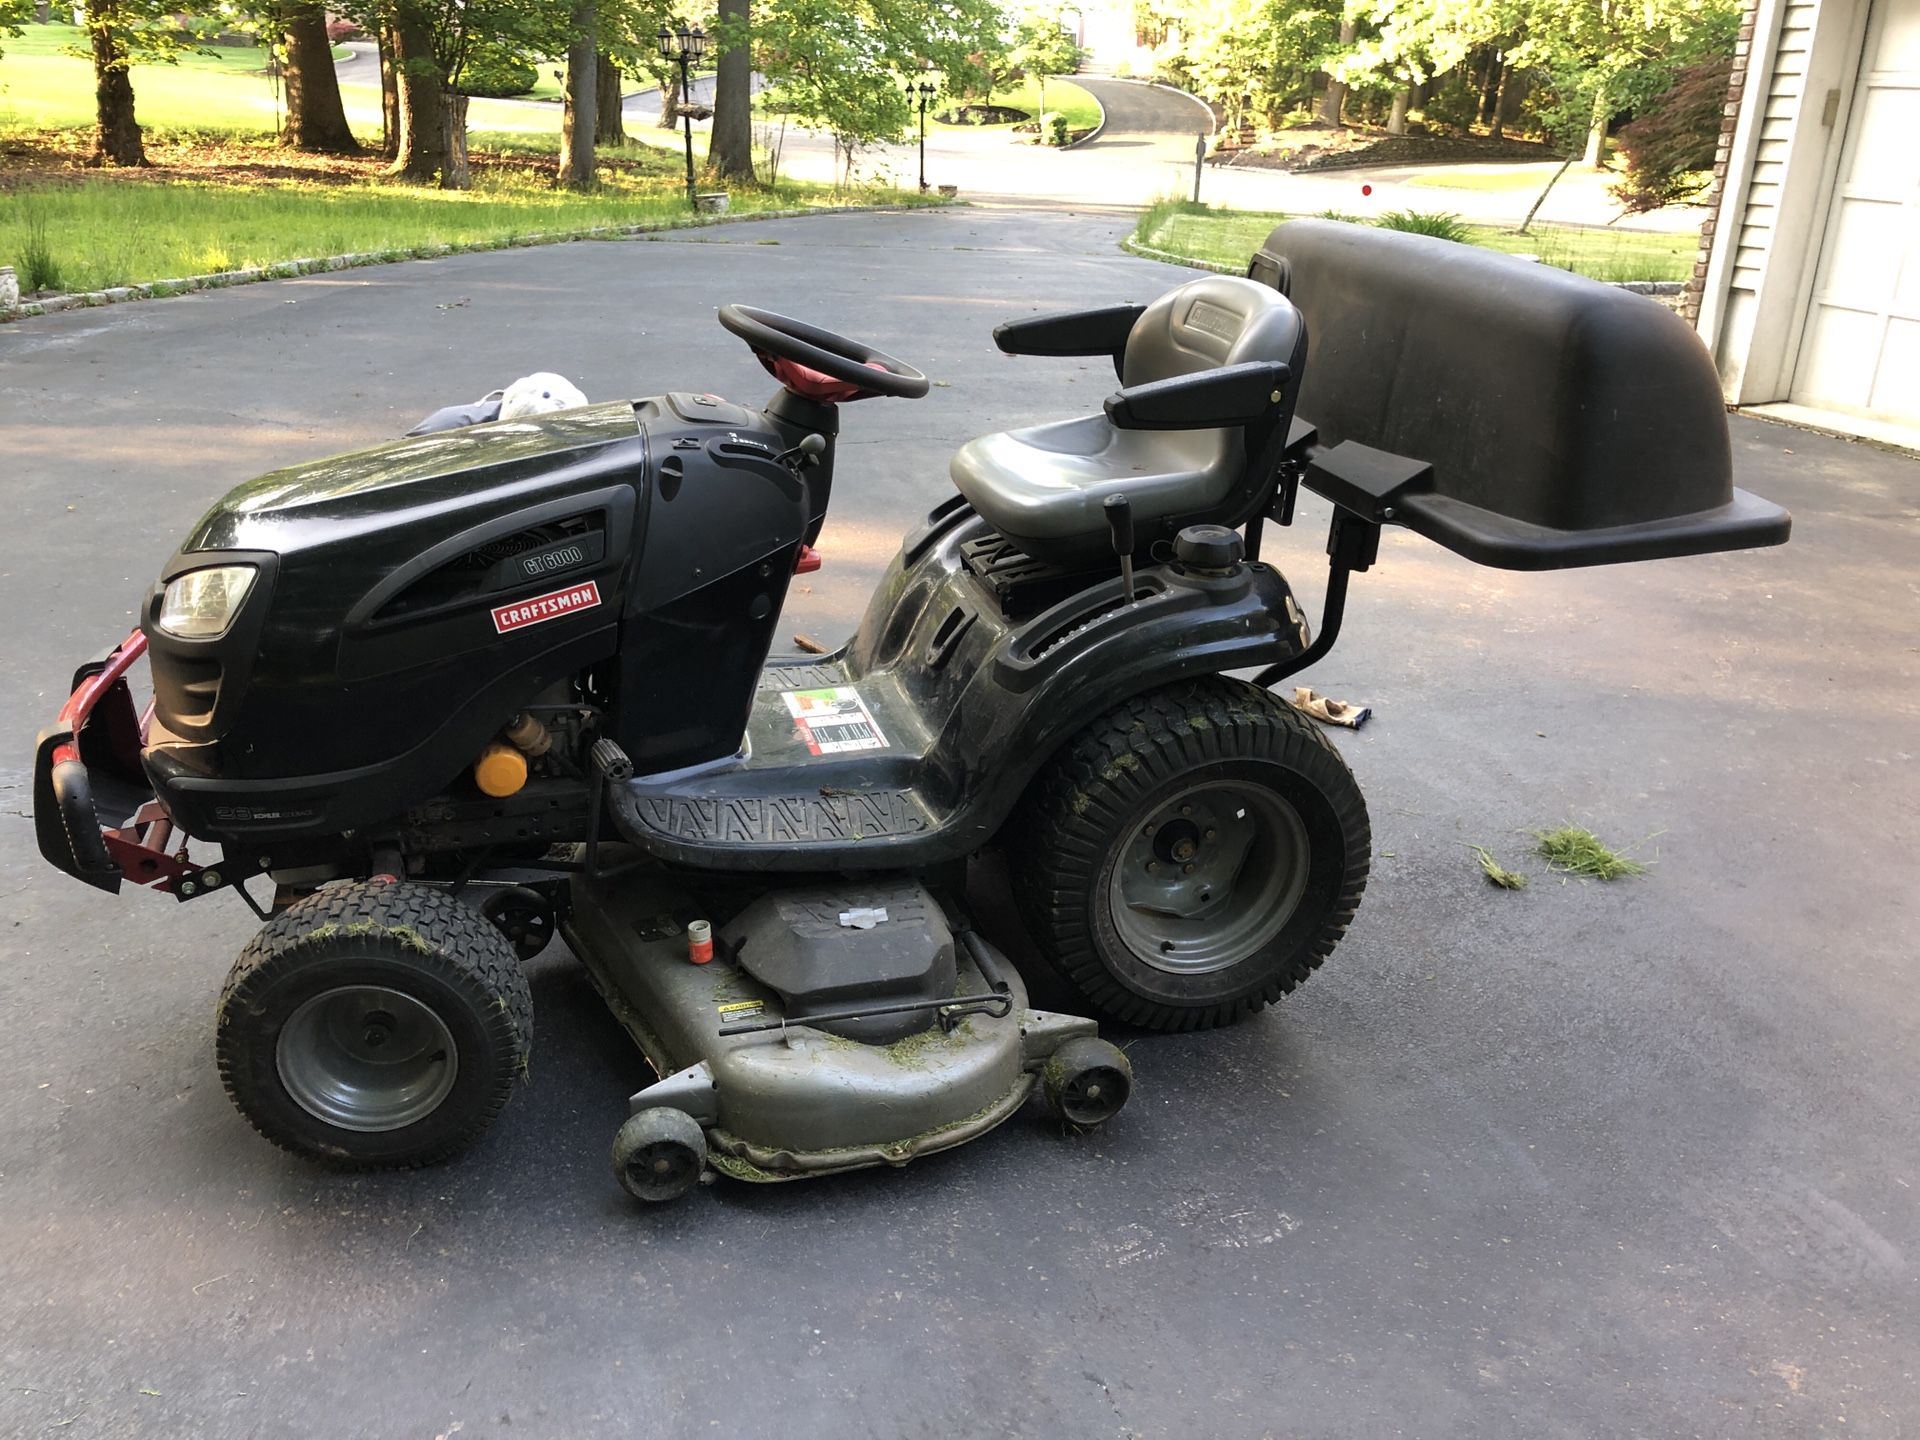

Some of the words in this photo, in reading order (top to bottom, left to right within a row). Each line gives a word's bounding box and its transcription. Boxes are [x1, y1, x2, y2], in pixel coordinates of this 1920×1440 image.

[523, 557, 546, 575] GT
[542, 546, 583, 570] 6000
[499, 588, 593, 626] CRAFTSMAN
